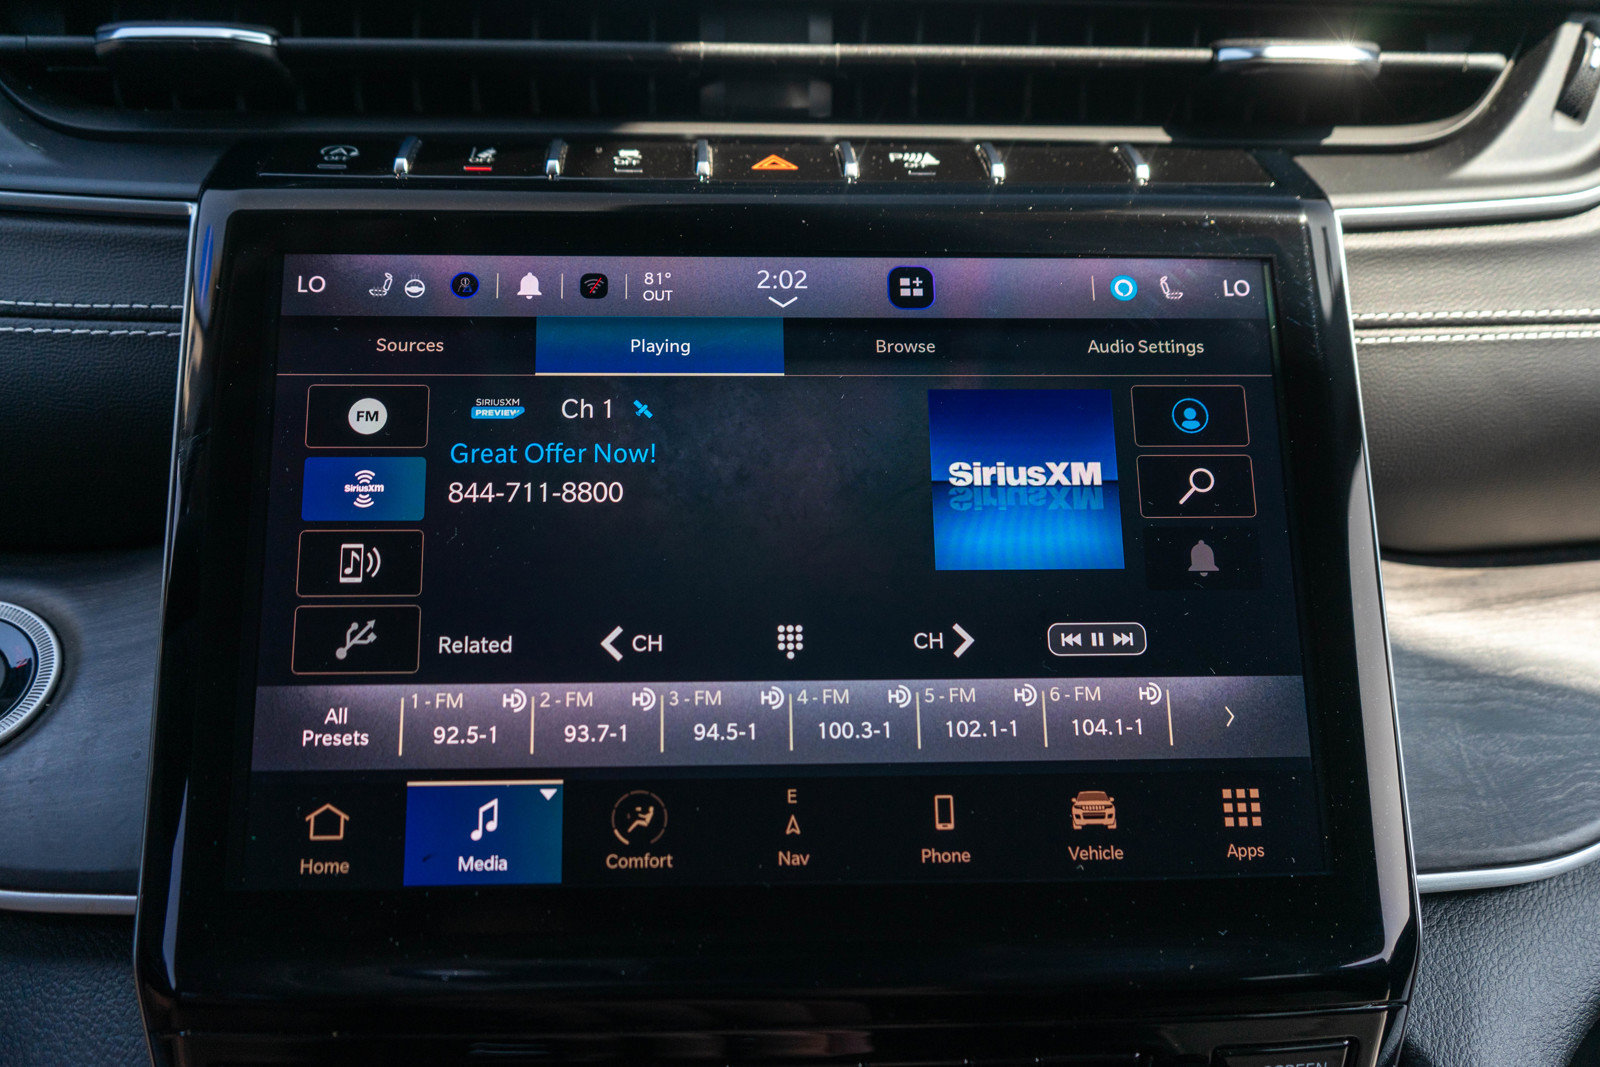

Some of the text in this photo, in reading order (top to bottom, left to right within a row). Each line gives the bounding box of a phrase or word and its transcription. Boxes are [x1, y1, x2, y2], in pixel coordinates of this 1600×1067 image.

[298, 276, 325, 292] LO
[645, 272, 671, 284] 81°
[758, 270, 807, 289] 2:02
[643, 290, 673, 301] OUT
[1224, 280, 1250, 296] LO
[377, 338, 443, 351] Sources
[632, 339, 690, 355] Playing
[876, 340, 935, 352] Browse
[1088, 340, 1204, 356] Audio Settings
[356, 410, 379, 422] FM
[562, 398, 611, 419] Ch 1
[451, 443, 655, 463] Great Offer Now!
[948, 461, 1102, 486] SiriusXM
[449, 482, 623, 503] 844-711-8800
[439, 636, 512, 653] Related
[632, 635, 662, 651] CH
[914, 633, 943, 649] CH
[436, 693, 463, 708] FM
[566, 691, 592, 707] FM
[695, 690, 721, 705] FM
[823, 689, 849, 704] FM
[950, 688, 975, 702] FM
[1075, 687, 1100, 701] FM
[325, 708, 347, 724] All
[434, 726, 496, 744] 92.5-1
[565, 725, 626, 742] 93.7-1
[694, 723, 755, 741] 94.5-1
[819, 722, 889, 739] 100.3-1
[947, 720, 1016, 737] 102.1-1
[1072, 719, 1142, 735] 104.1-1
[302, 730, 369, 746] Presets
[788, 789, 797, 803] E
[779, 851, 809, 865] Nav
[922, 848, 970, 863] Phone
[1068, 845, 1123, 860] Vehicle
[1227, 844, 1264, 860] Apps
[300, 859, 349, 874] Home
[459, 855, 507, 871] Media
[606, 853, 672, 869] Comfort
